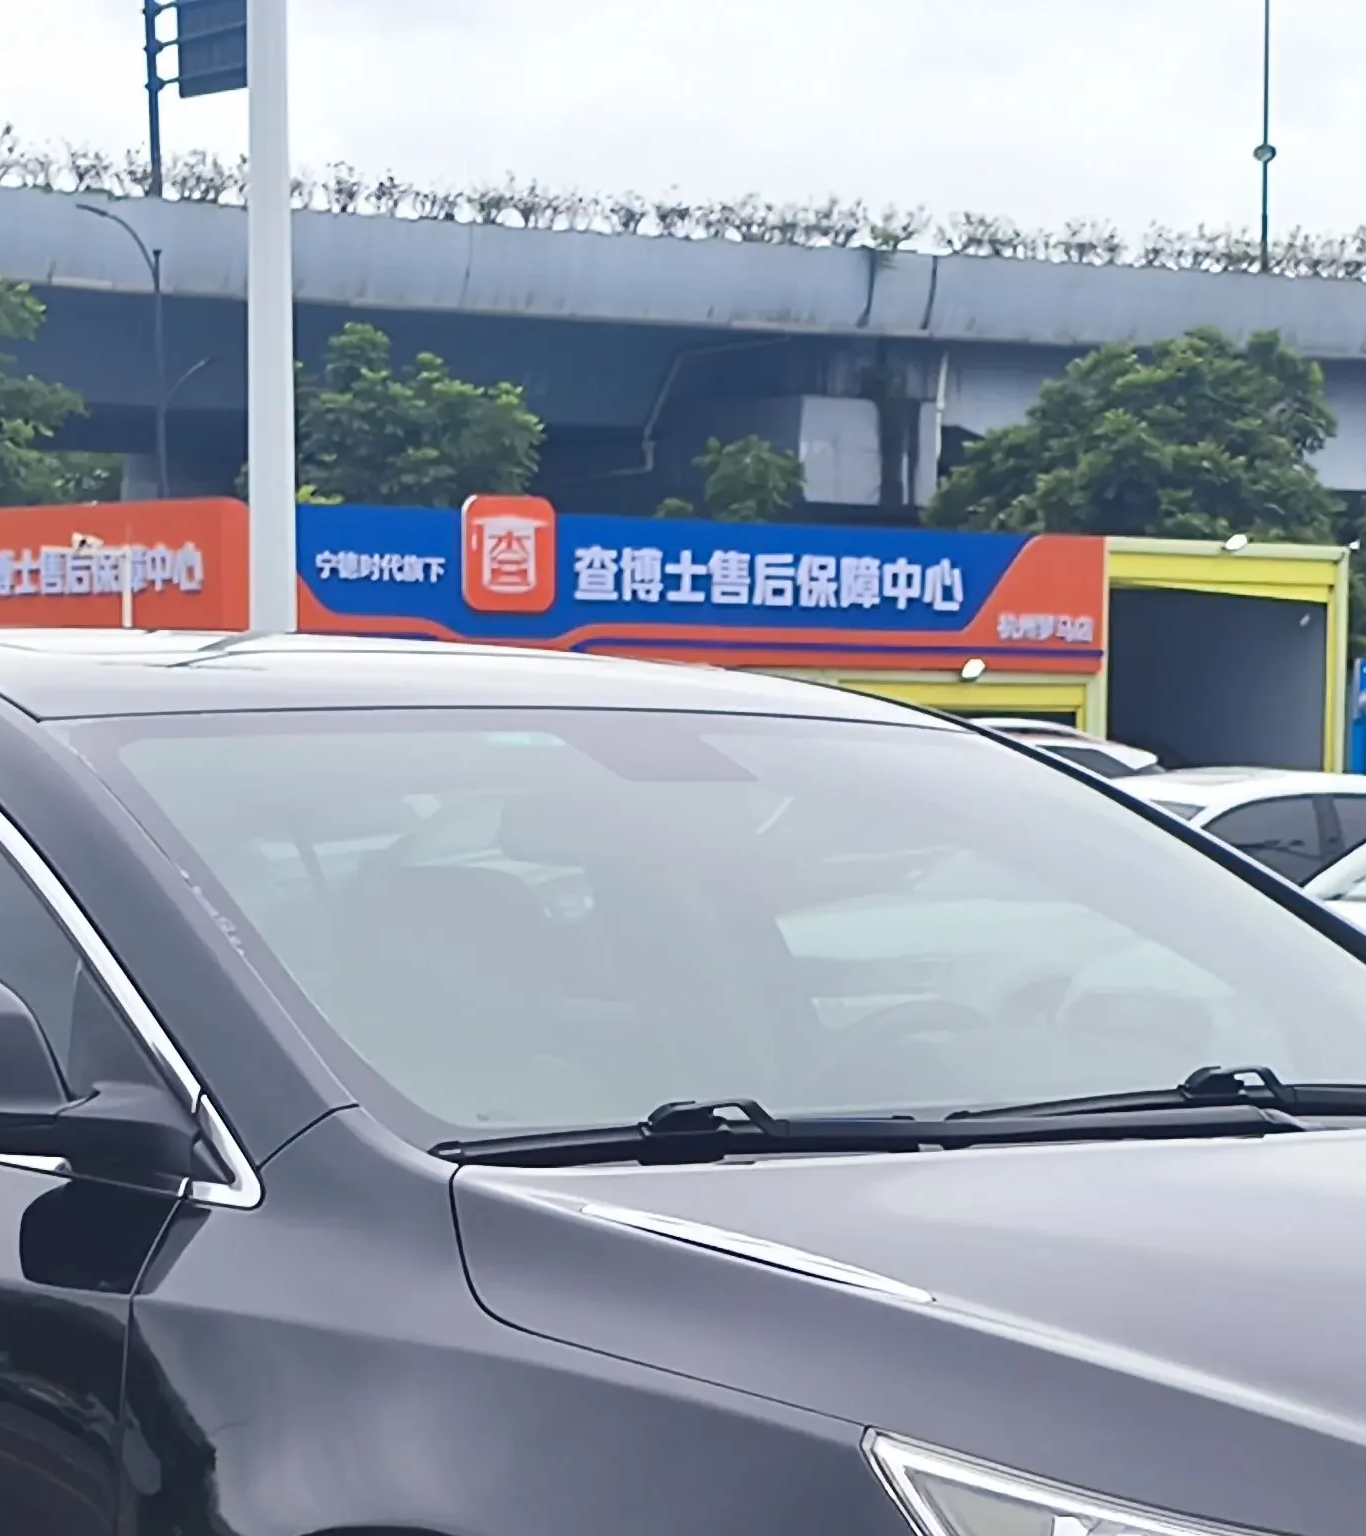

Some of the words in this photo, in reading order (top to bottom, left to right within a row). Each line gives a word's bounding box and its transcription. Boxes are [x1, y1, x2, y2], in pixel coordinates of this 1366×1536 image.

[315, 551, 446, 583] 宁德时代旗下
[572, 544, 965, 613] 查博士售后保障中心
